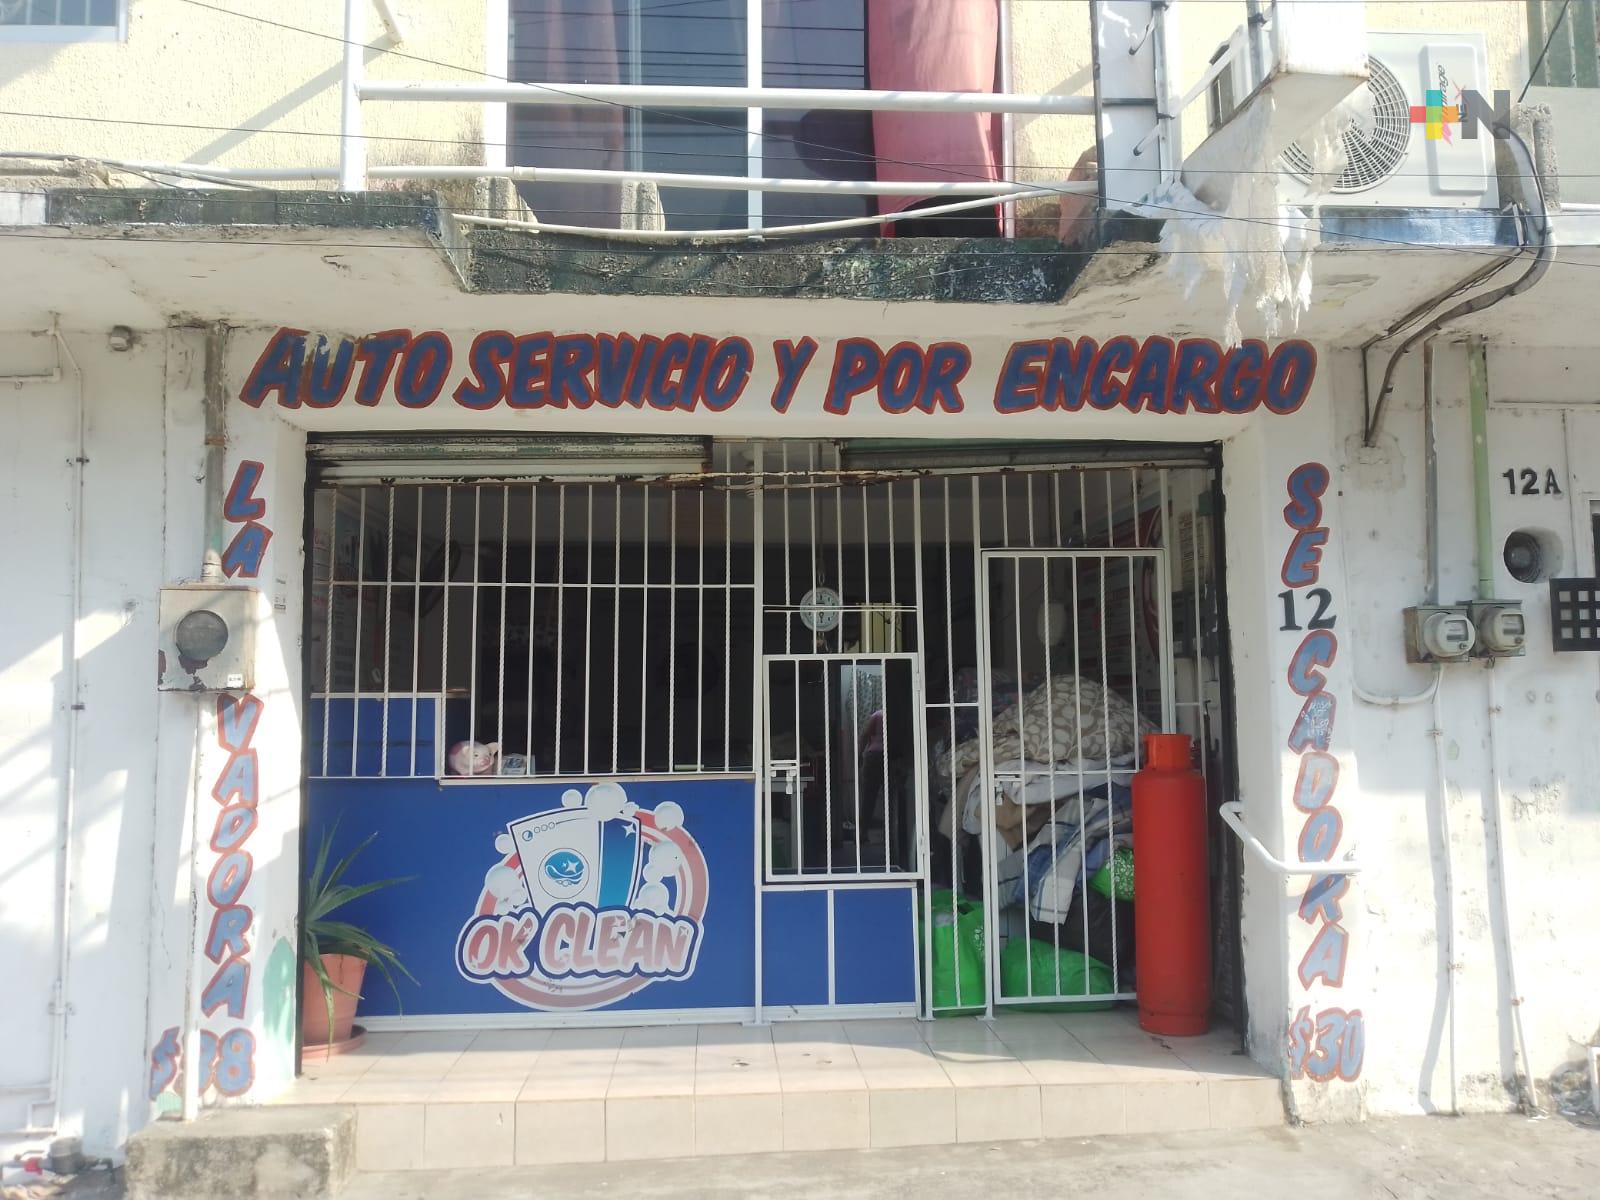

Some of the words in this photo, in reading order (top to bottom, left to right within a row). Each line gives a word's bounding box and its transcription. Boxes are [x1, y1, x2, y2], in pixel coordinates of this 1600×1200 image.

[239, 327, 452, 409] AUTO
[452, 330, 754, 412] SERVICIO
[771, 336, 818, 414] Y
[823, 337, 971, 415] POR
[993, 336, 1317, 415] ENCARGO
[1502, 468, 1562, 495] 12A
[1277, 588, 1338, 631] 12
[465, 914, 537, 972] OK
[542, 910, 692, 973] CLEAN
[1288, 1004, 1365, 1083] $30
